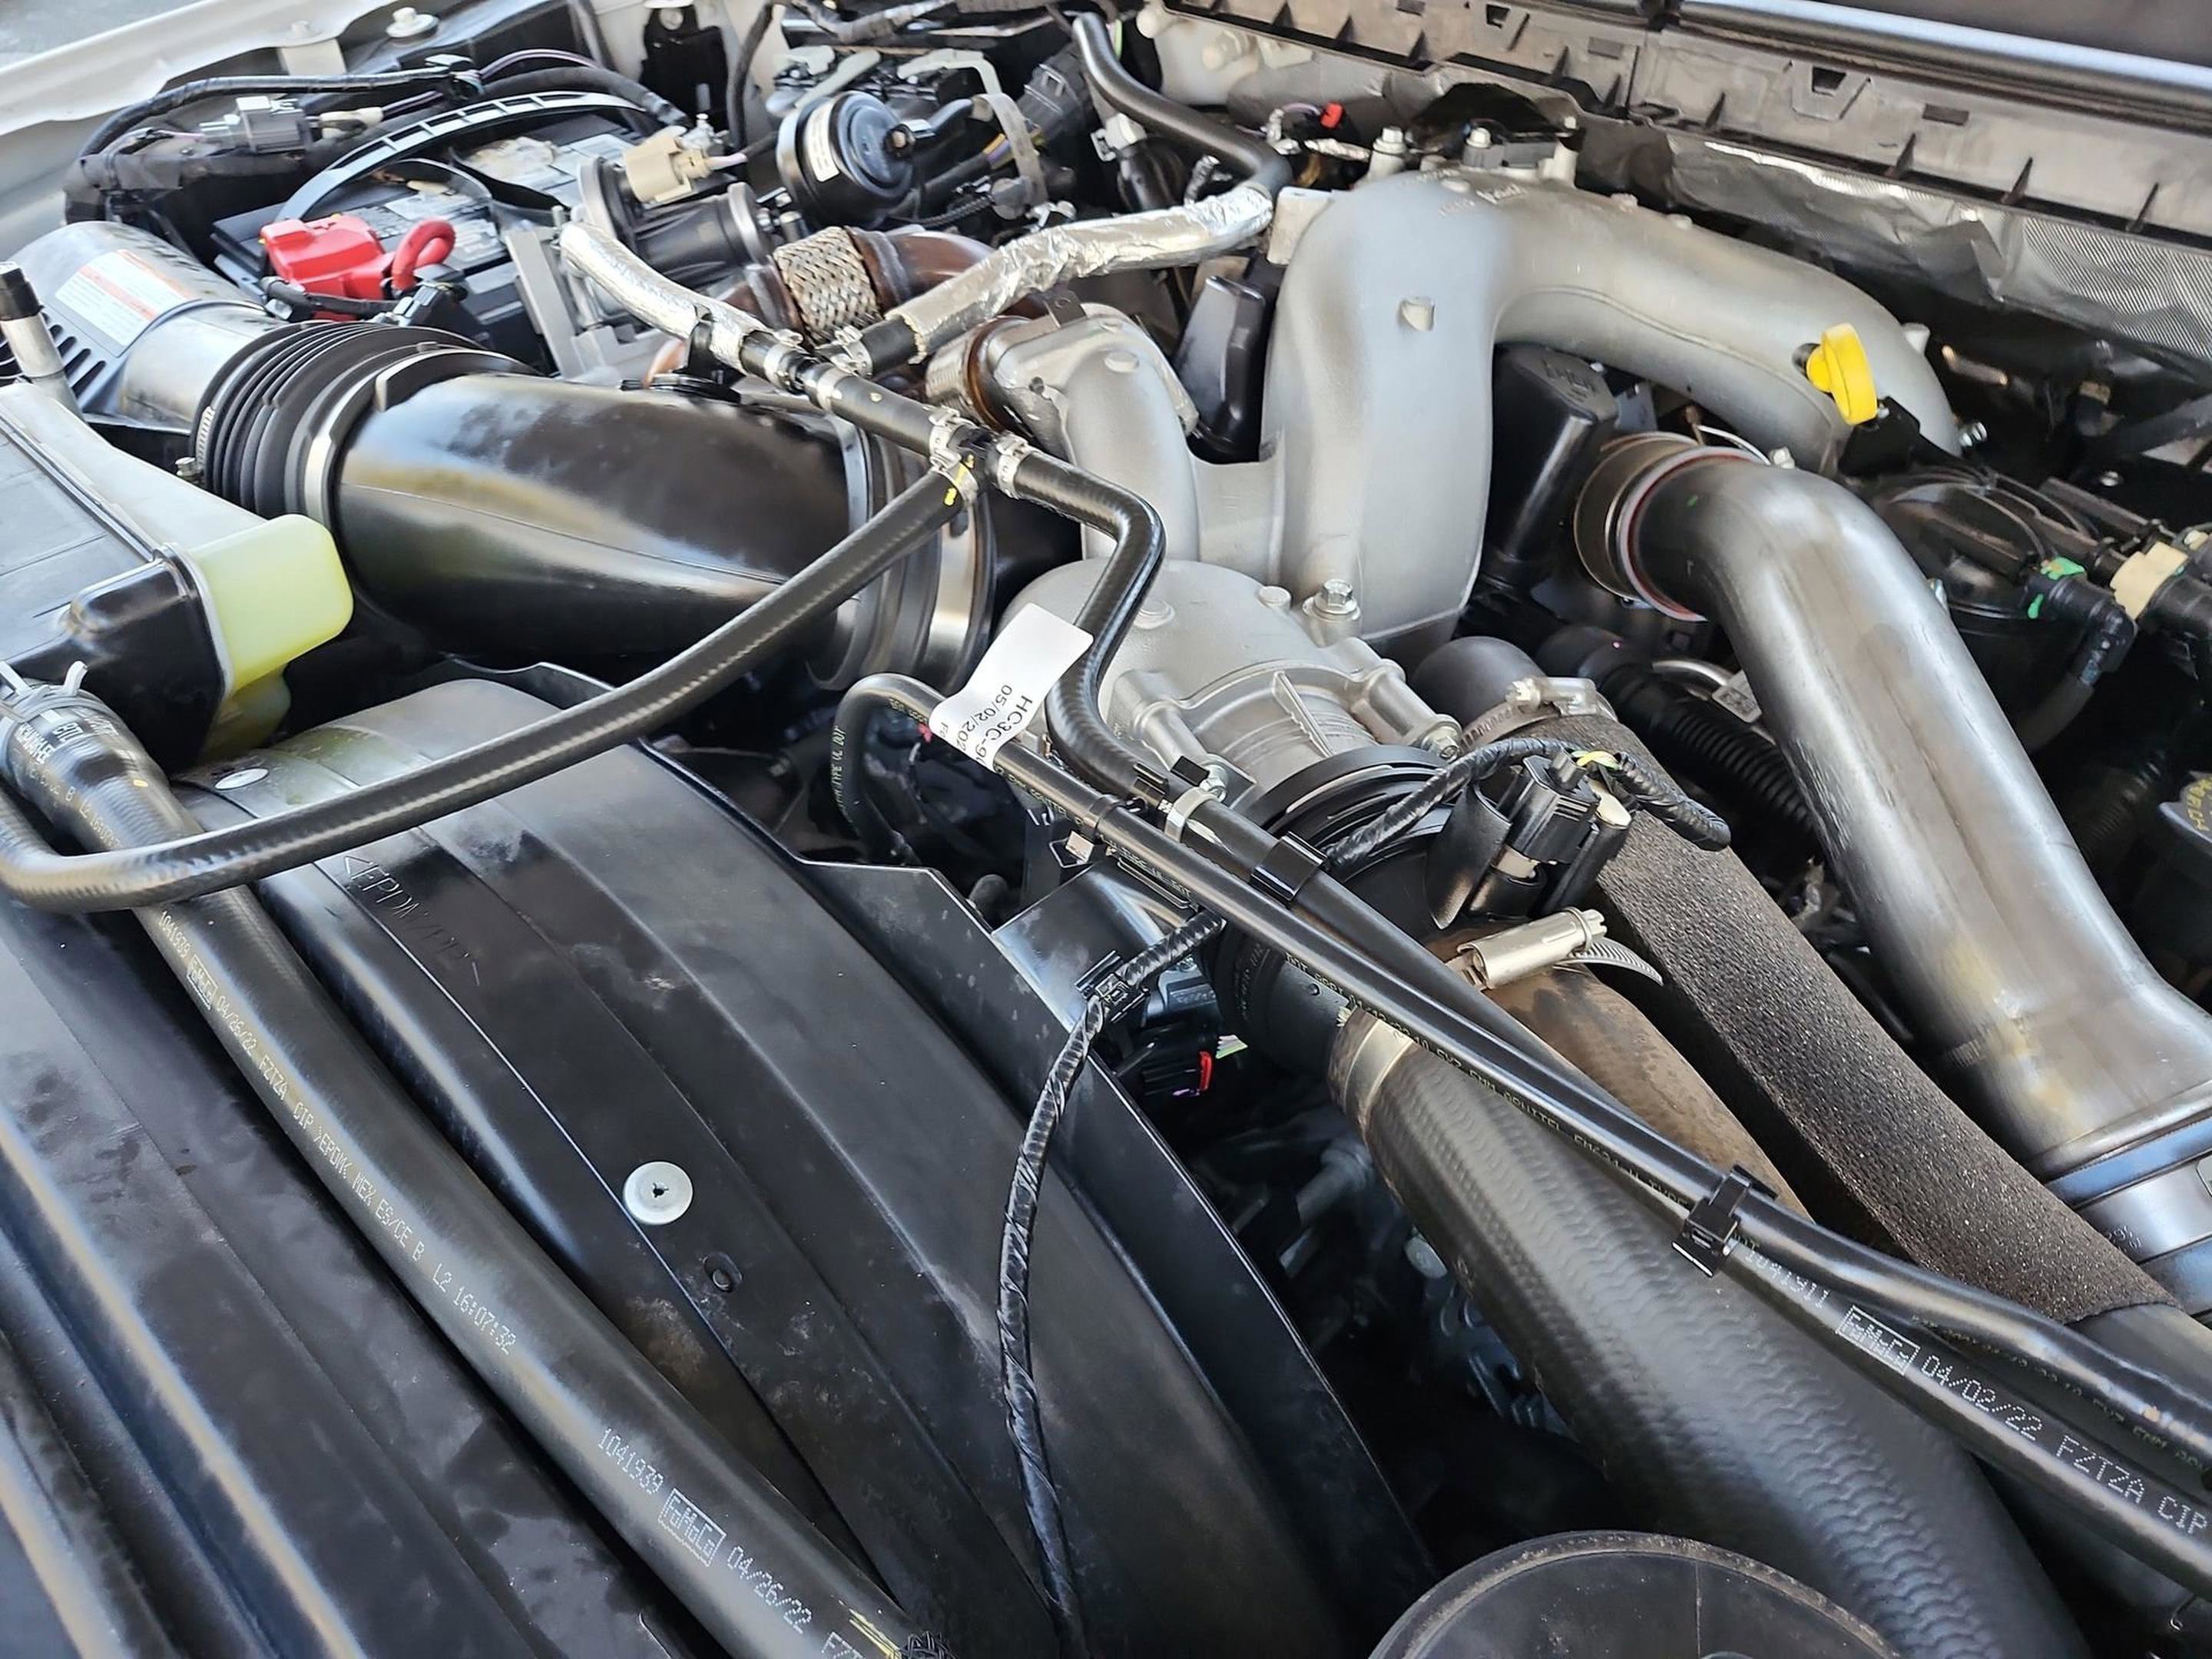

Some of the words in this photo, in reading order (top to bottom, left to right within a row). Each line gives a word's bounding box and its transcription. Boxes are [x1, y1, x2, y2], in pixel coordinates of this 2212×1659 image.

[452, 1286, 516, 1355] 16:07:32
[1920, 1354, 2043, 1442] 04/02/22
[2055, 1434, 2145, 1504] FZTZA
[598, 1428, 664, 1495] 1041939
[727, 1545, 813, 1634] 04/26/22
